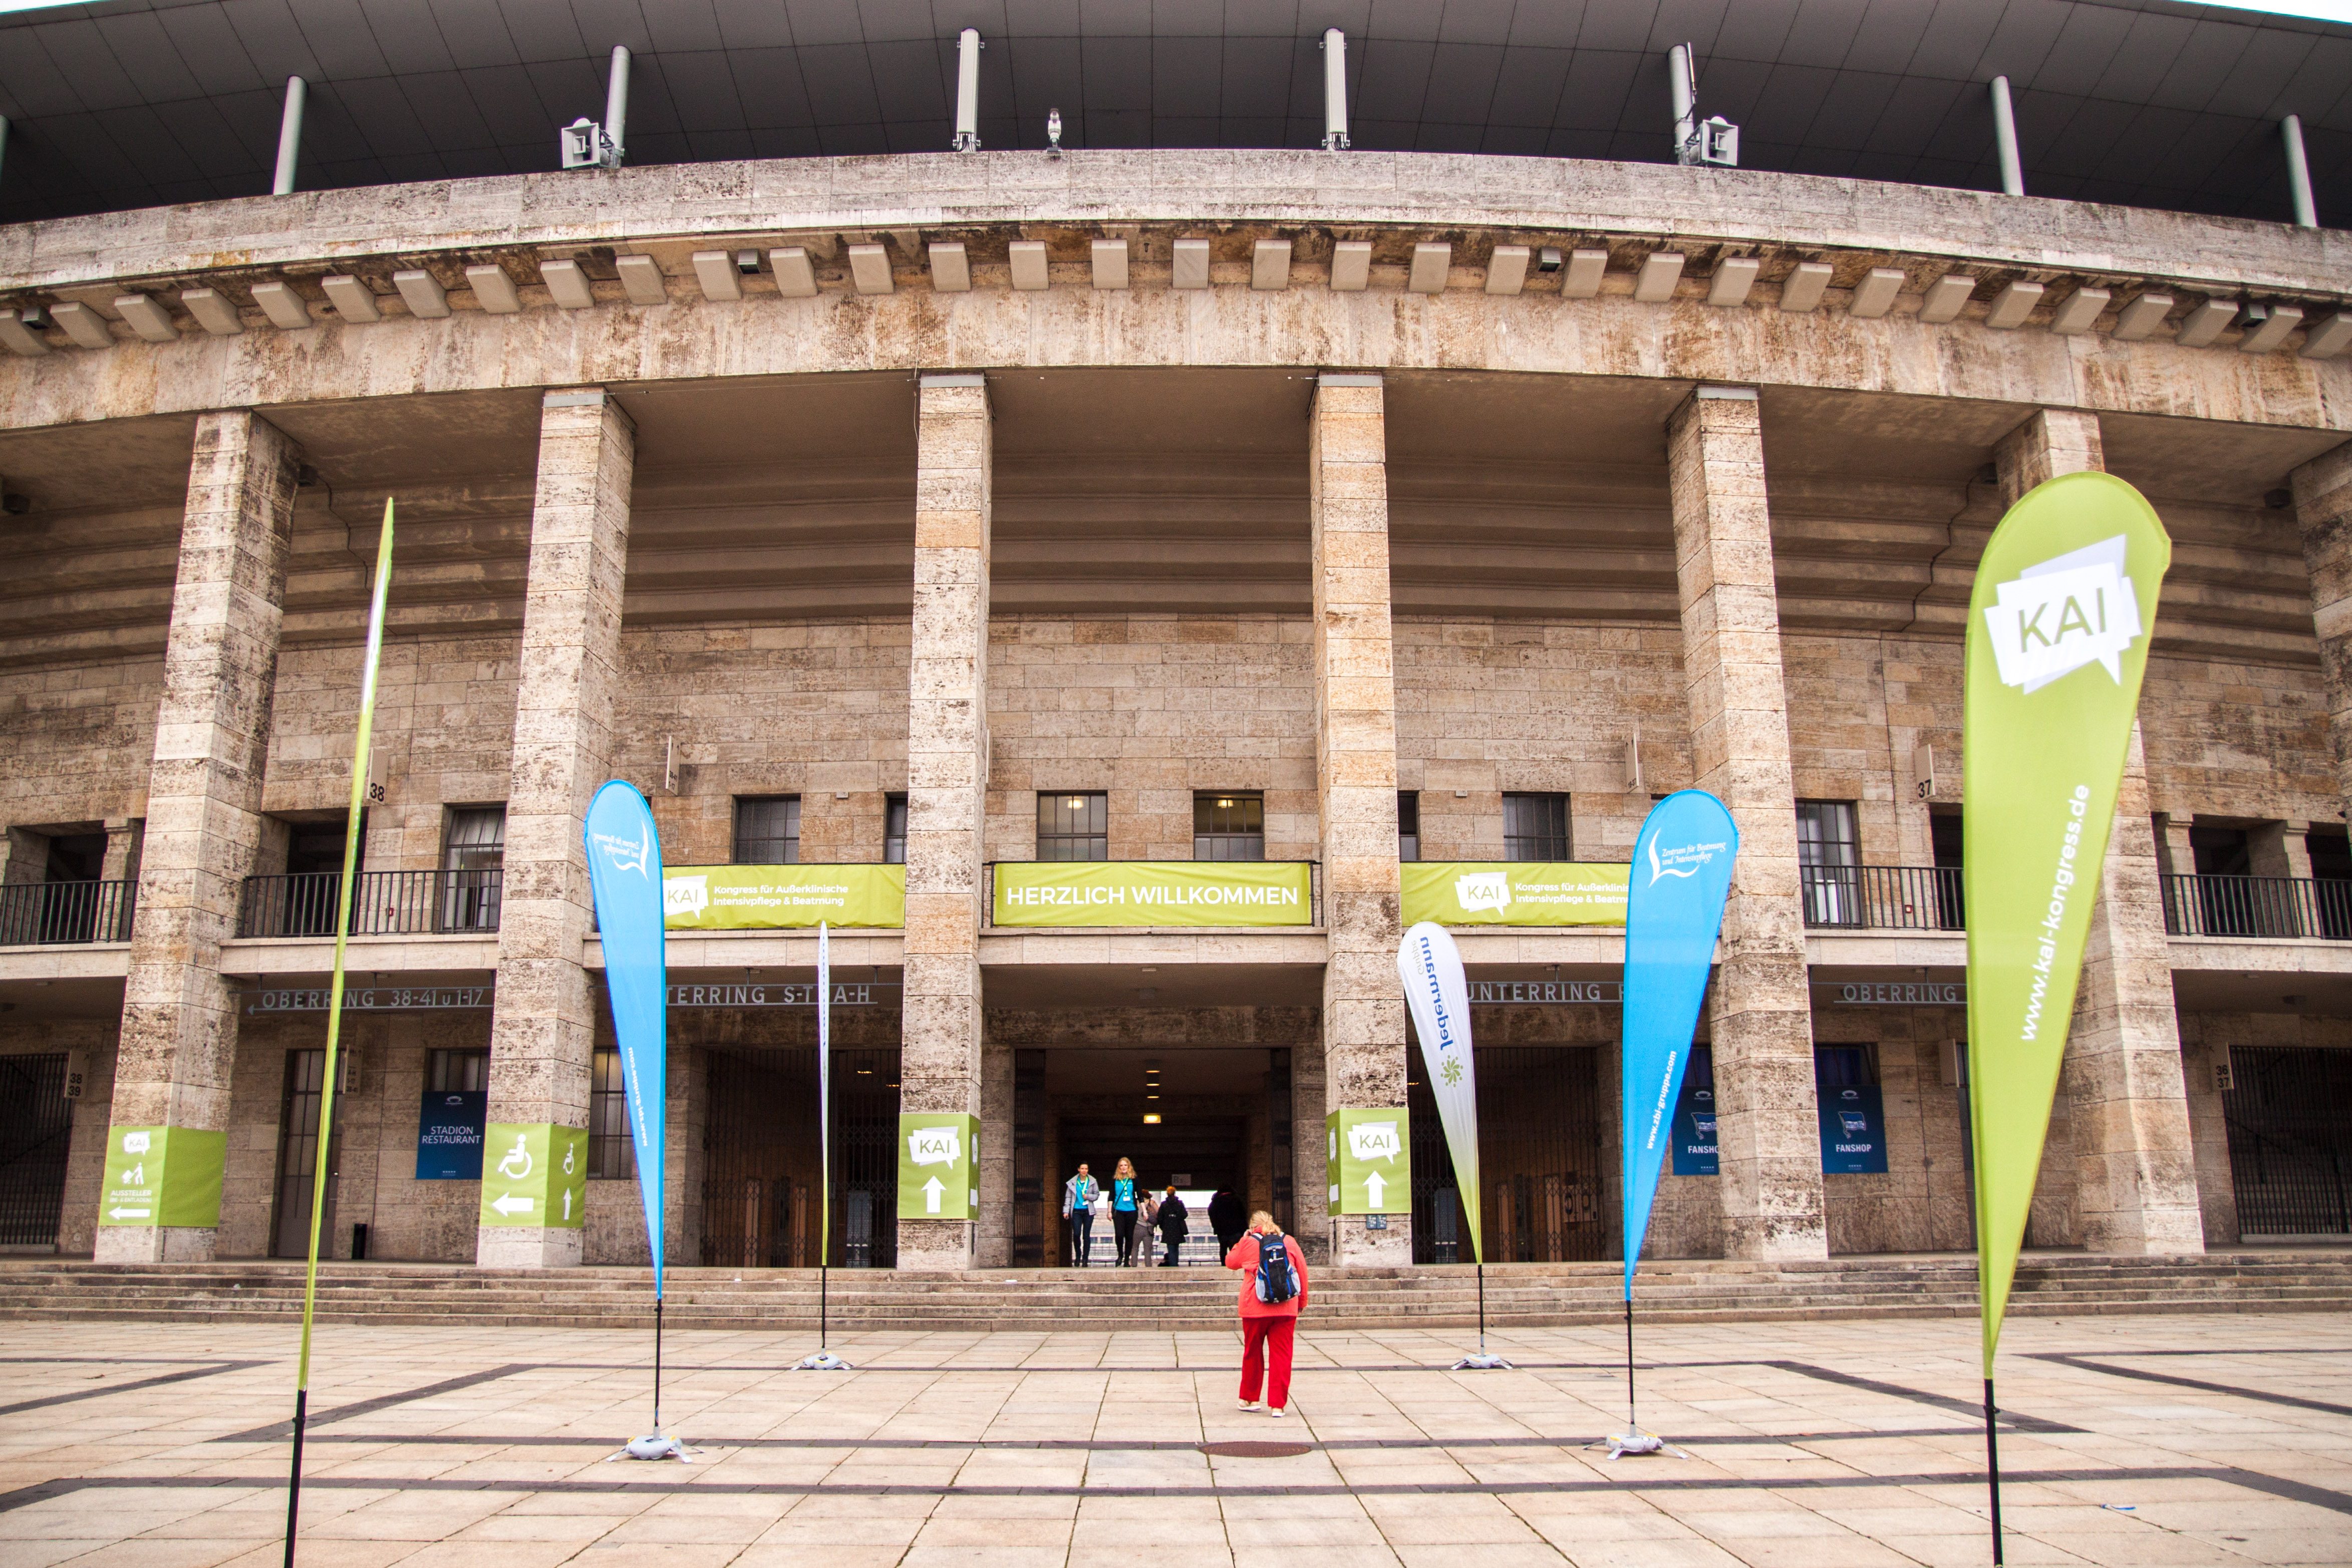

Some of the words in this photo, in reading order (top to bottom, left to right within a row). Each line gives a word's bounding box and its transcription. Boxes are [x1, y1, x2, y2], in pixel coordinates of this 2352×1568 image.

[2018, 587, 2106, 653] KAI
[370, 782, 385, 802] 38
[1918, 779, 1931, 798] 37
[1661, 847, 1686, 857] Zentrum
[1686, 844, 1696, 855] für
[1696, 841, 1726, 852] Beatmung
[1662, 856, 1673, 865] und
[1674, 851, 1713, 864] Intensivpflege
[714, 885, 758, 895] Kongress
[760, 884, 773, 893] für
[776, 884, 848, 893] Außerklinische
[1467, 885, 1499, 899] KAI
[1515, 883, 1559, 892] Kongress
[1561, 882, 1574, 891] für
[1577, 883, 1629, 892] Außerklinis
[668, 889, 698, 903] KAI
[714, 896, 781, 907] Intensivpflege
[783, 896, 790, 905] &
[793, 896, 844, 906] Beatmung
[1007, 886, 1124, 905] HERZLICH
[1131, 886, 1298, 905] WILLKOMMEN
[1516, 895, 1583, 905] Intensivpflege
[1586, 895, 1593, 903] &
[1595, 895, 1628, 903] Beatm
[2020, 784, 2090, 1040] www.kai-kongress.de
[262, 991, 375, 1009] OBERRNG
[391, 990, 436, 1007] 38-41
[456, 989, 484, 1006] 1-17
[666, 986, 765, 1004] TERRING
[784, 986, 813, 1003] S-T
[834, 986, 869, 1002] A-H
[1843, 984, 1956, 1002] OBERRING
[2216, 1065, 2228, 1076] 36
[70, 1073, 82, 1084] 38
[2218, 1077, 2229, 1088] 37
[69, 1085, 81, 1096] 39
[1647, 1051, 1677, 1149] www.zbi-gruppe.com
[431, 1126, 473, 1135] STADION
[129, 1138, 145, 1147] KAI
[422, 1135, 481, 1144] RESTAURANT
[920, 1139, 950, 1154] KAI
[1359, 1134, 1390, 1149] KAI
[1687, 1145, 1718, 1154] FANSHO
[1836, 1144, 1871, 1152] FANSHOP
